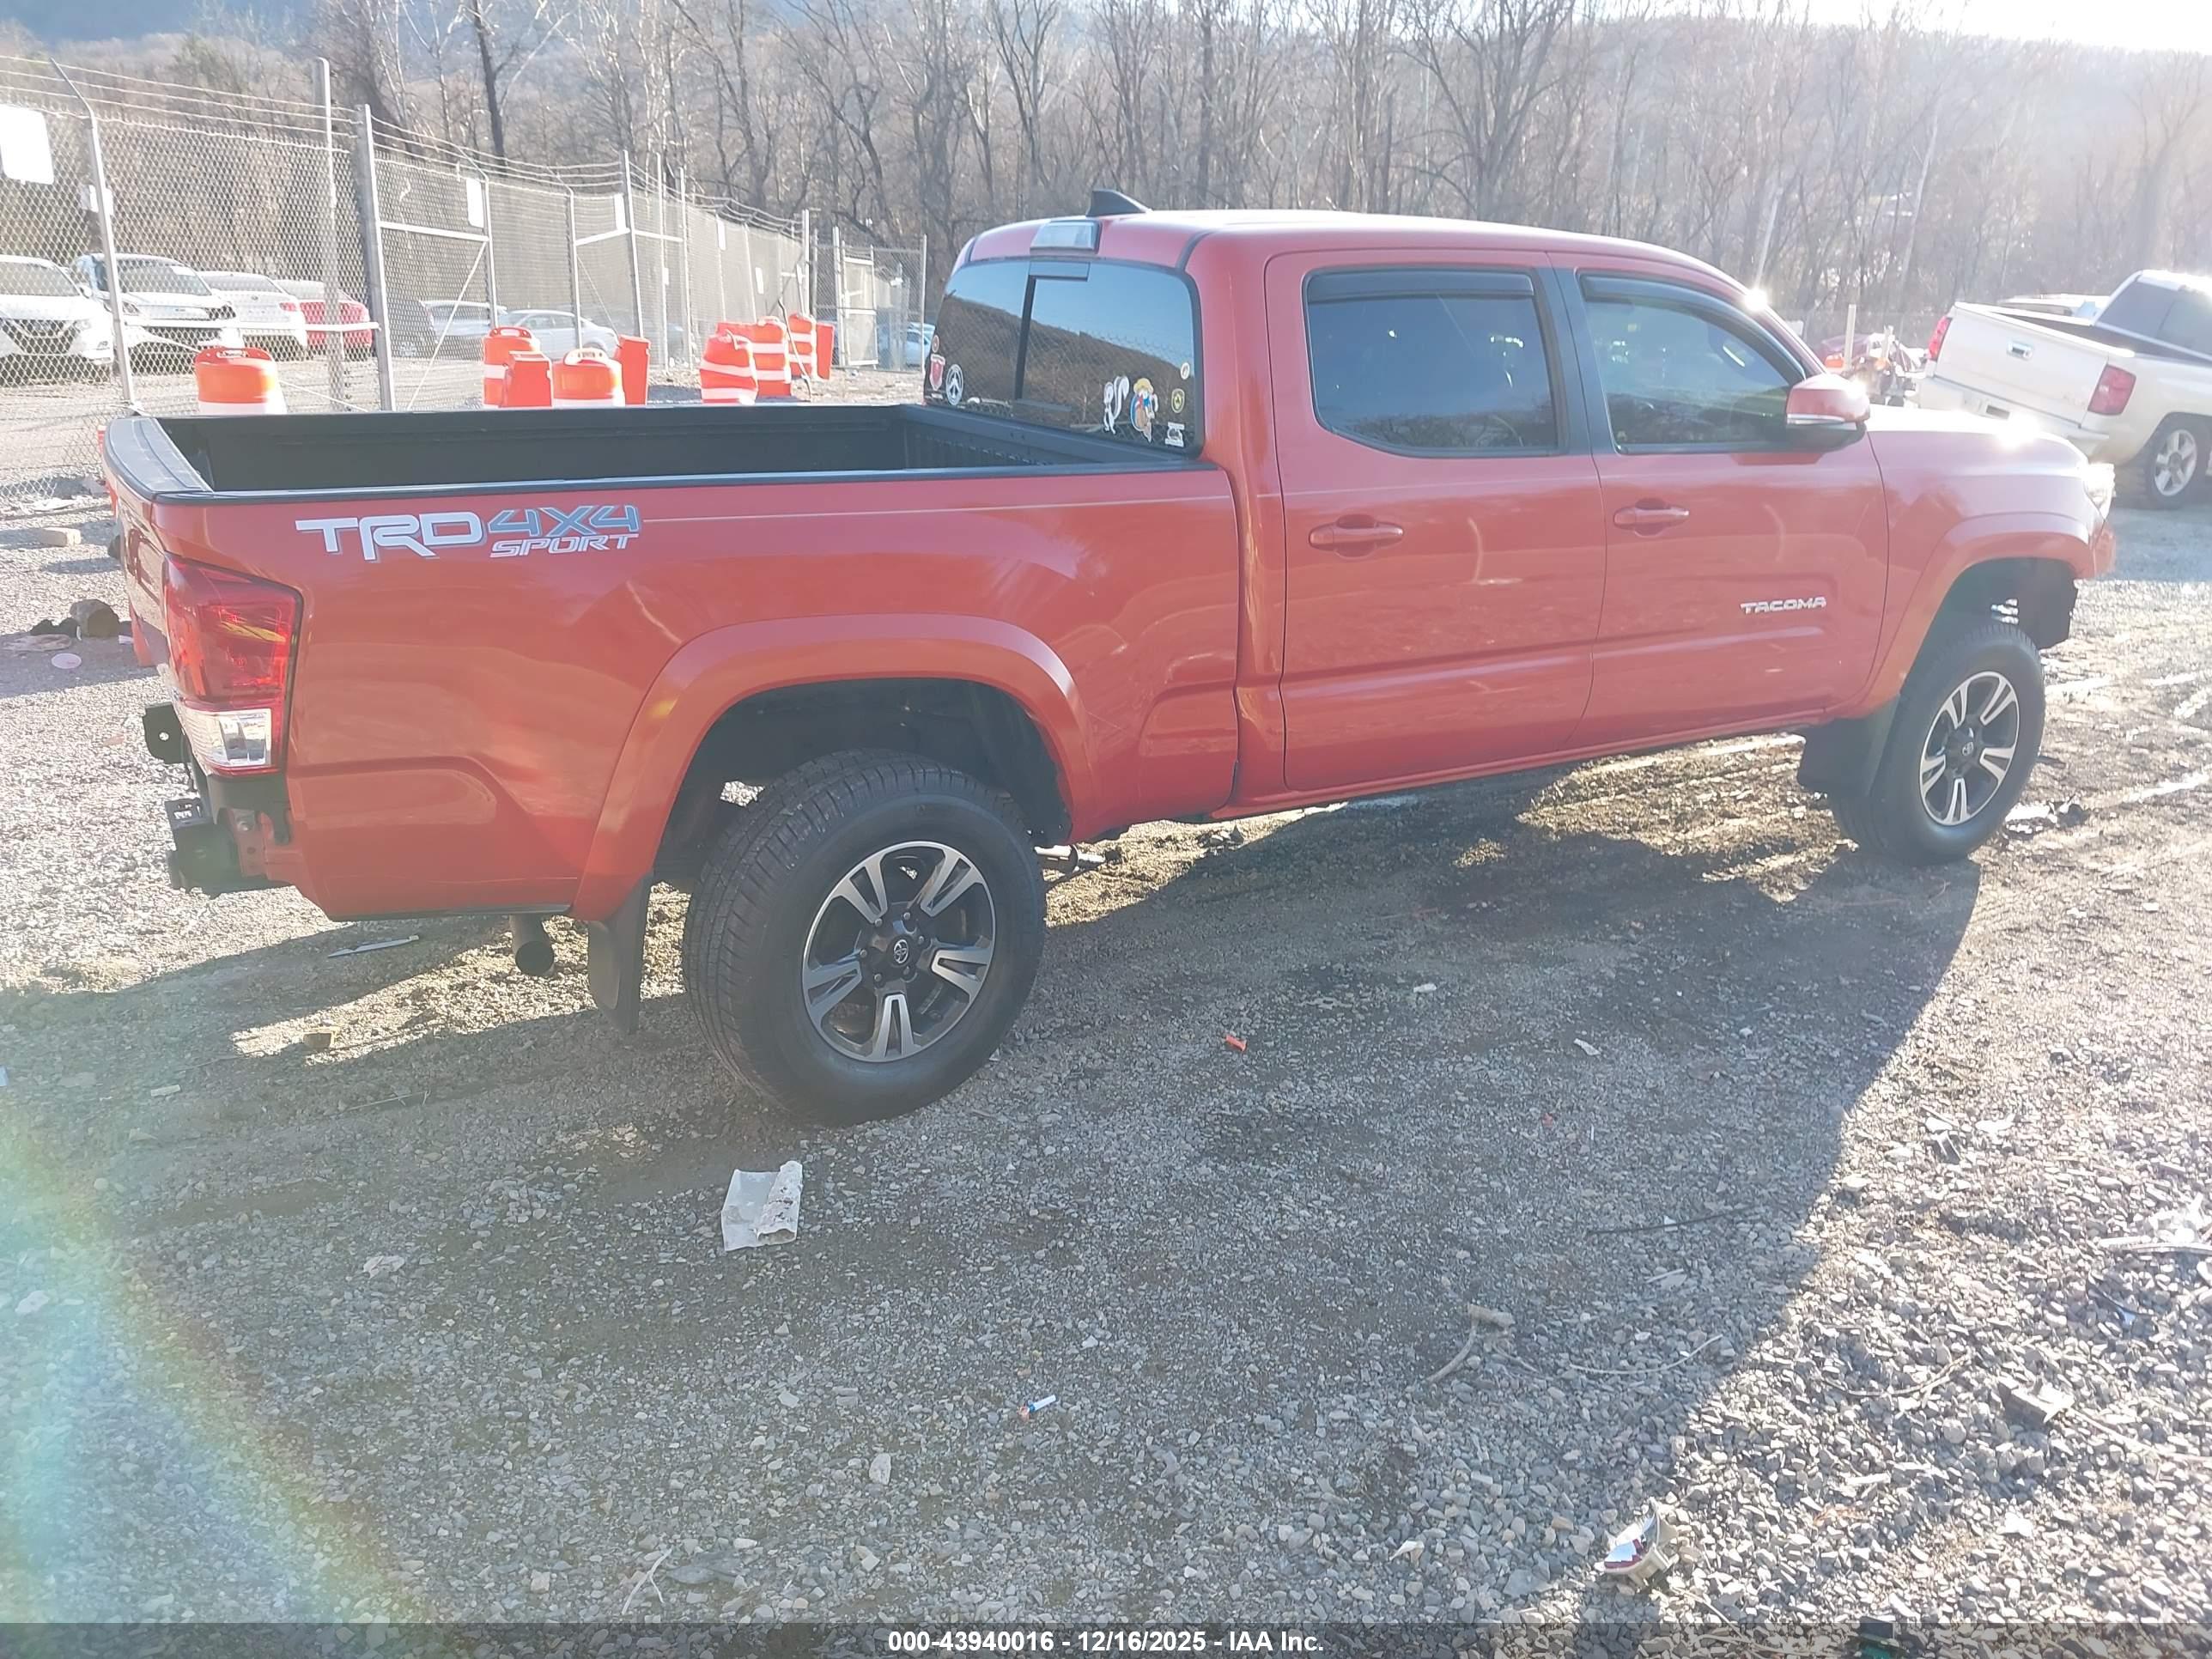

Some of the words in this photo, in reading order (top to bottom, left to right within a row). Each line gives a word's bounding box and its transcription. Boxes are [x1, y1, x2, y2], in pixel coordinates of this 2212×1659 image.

[295, 511, 486, 562] TRD
[489, 533, 639, 558] SPORT
[1740, 597, 1827, 615] TACOMA
